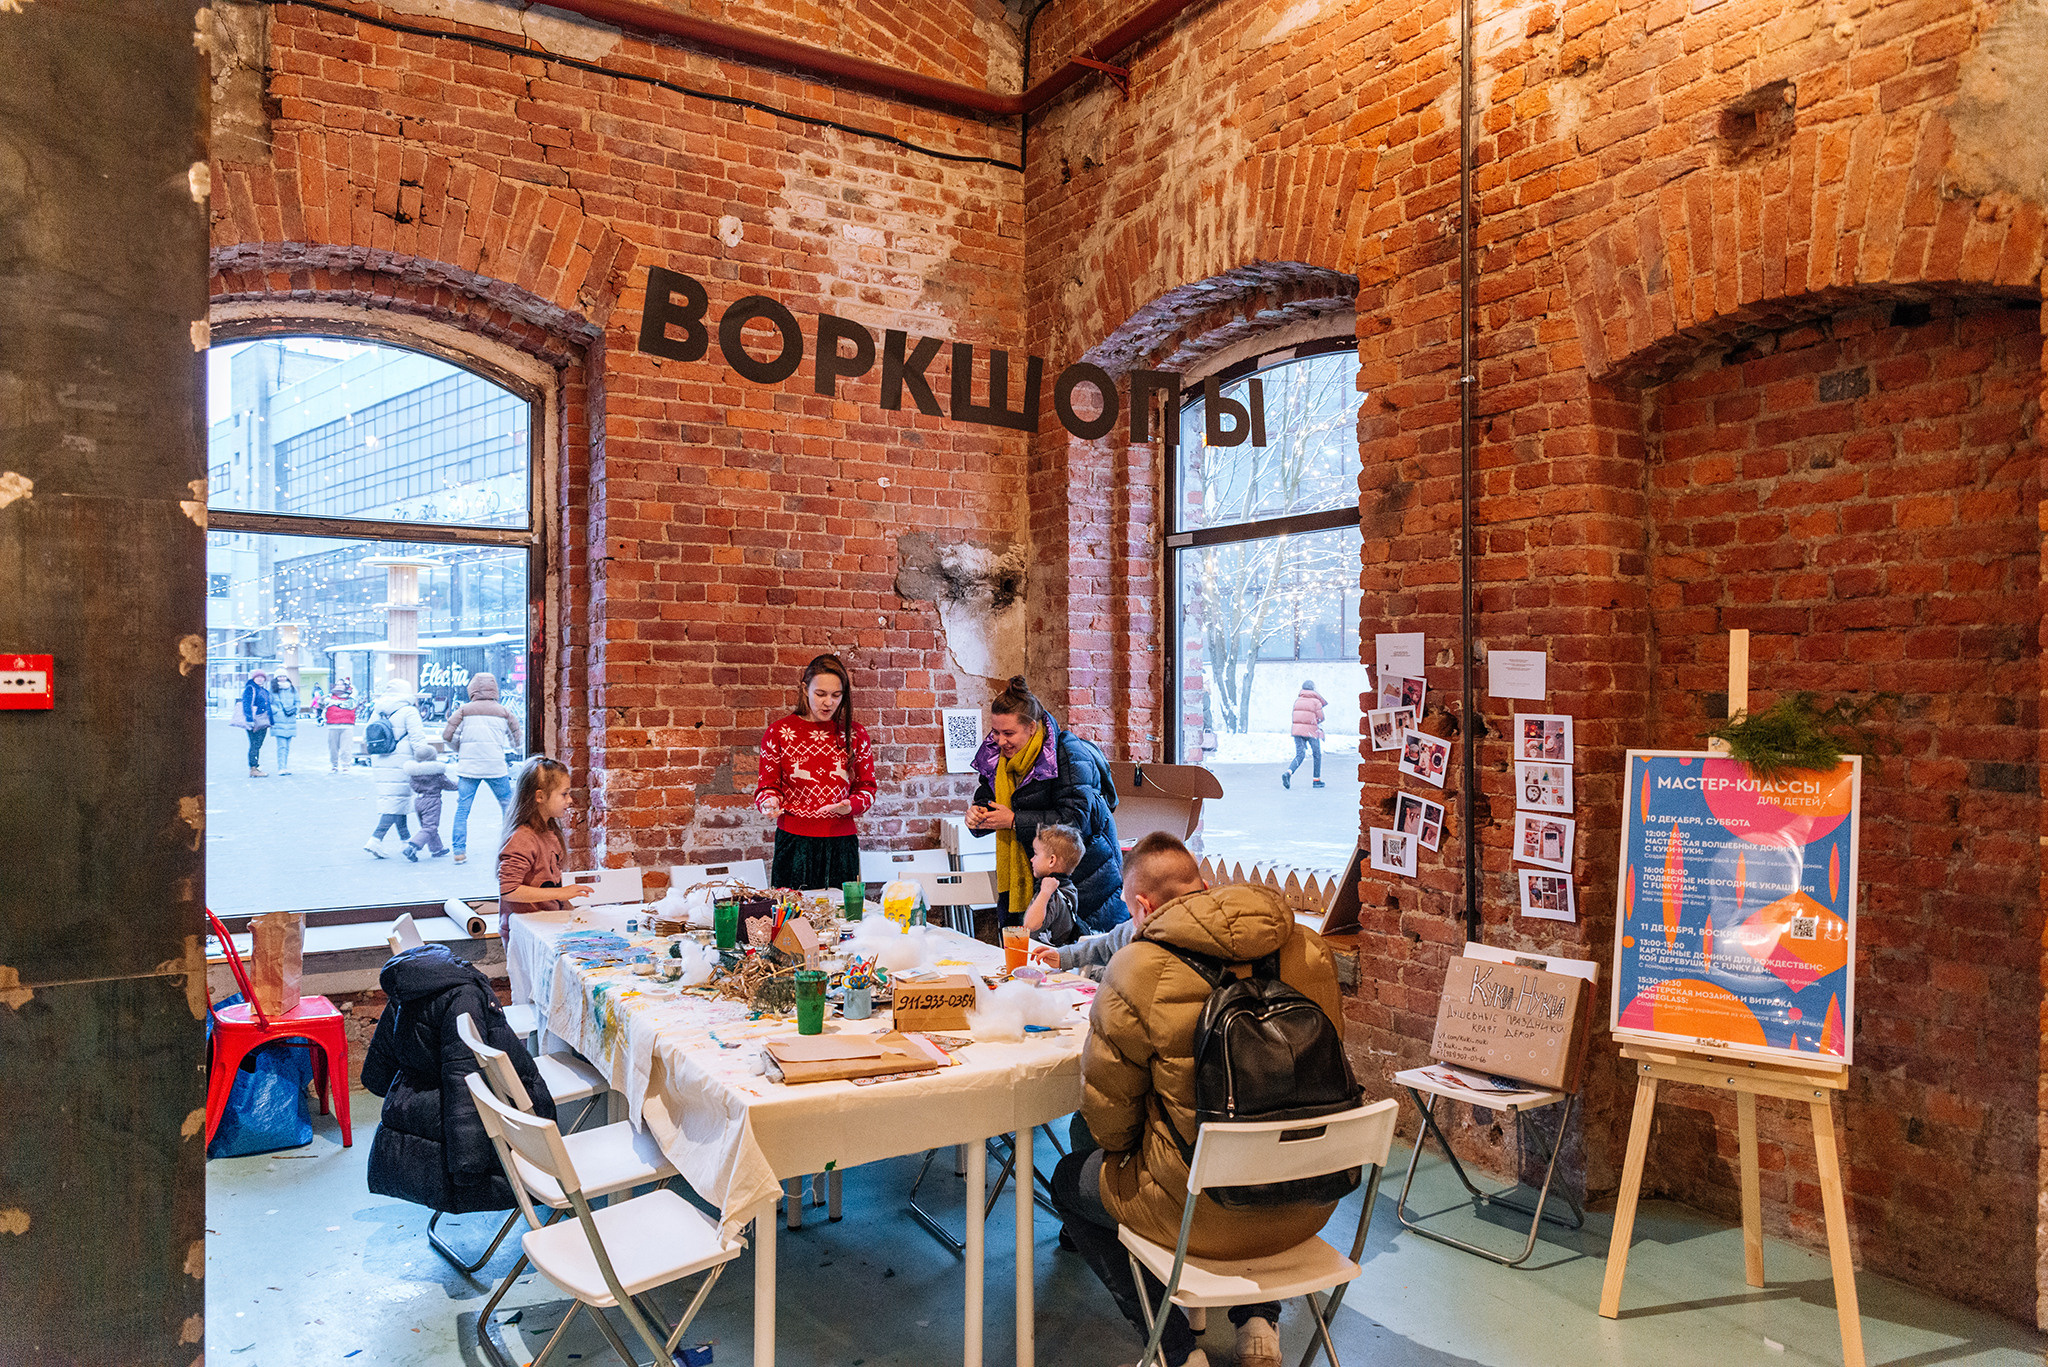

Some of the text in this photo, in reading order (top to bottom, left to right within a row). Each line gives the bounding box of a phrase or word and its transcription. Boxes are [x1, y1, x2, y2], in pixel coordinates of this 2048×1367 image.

[638, 265, 1267, 448] ВОРКШОПЫ
[1658, 776, 1820, 794] МАСТЕР-КЛАССЫ
[1757, 796, 1820, 807] ДЛЯ ДЕТЕЙ
[1658, 816, 1704, 826] ДЕКАБРЯ,
[1706, 817, 1751, 827] СУББОТА
[1645, 830, 1690, 839] 12:00-16:00
[1645, 838, 1805, 853] МАСТЕРСКАЯ ВОЛШЕБНЫХ ДОМИКВ
[1653, 846, 1704, 855] КУКИ-НУКИ:
[1643, 867, 1689, 876] 16:00-18:00
[1643, 874, 1696, 884] ПОДВЕСНЫЕ
[1697, 878, 1757, 888] НОВОГОДНИЕ
[1651, 882, 1678, 890] FUNKY
[1679, 884, 1698, 892] JAM:
[1641, 923, 1649, 931] 11
[1650, 924, 1697, 936] ДЕКАБРЯ,
[1640, 939, 1685, 949] 13:00-15:00
[1639, 947, 1692, 958] КАРТОННЫЕ
[1693, 952, 1731, 962] ДОМИКИ
[1733, 955, 1752, 964] ДЛЯ
[1639, 953, 1657, 962] КОЙ
[1658, 956, 1711, 967] ДЕРЕВУШКИ
[1721, 962, 1751, 971] FUNKY
[1752, 965, 1771, 974] JAM:
[1637, 984, 1693, 997] МАСТЕРСКАЯ
[1695, 991, 1738, 1002] МОЗАИКИ
[1637, 992, 1689, 1004] MOREGLASS:
